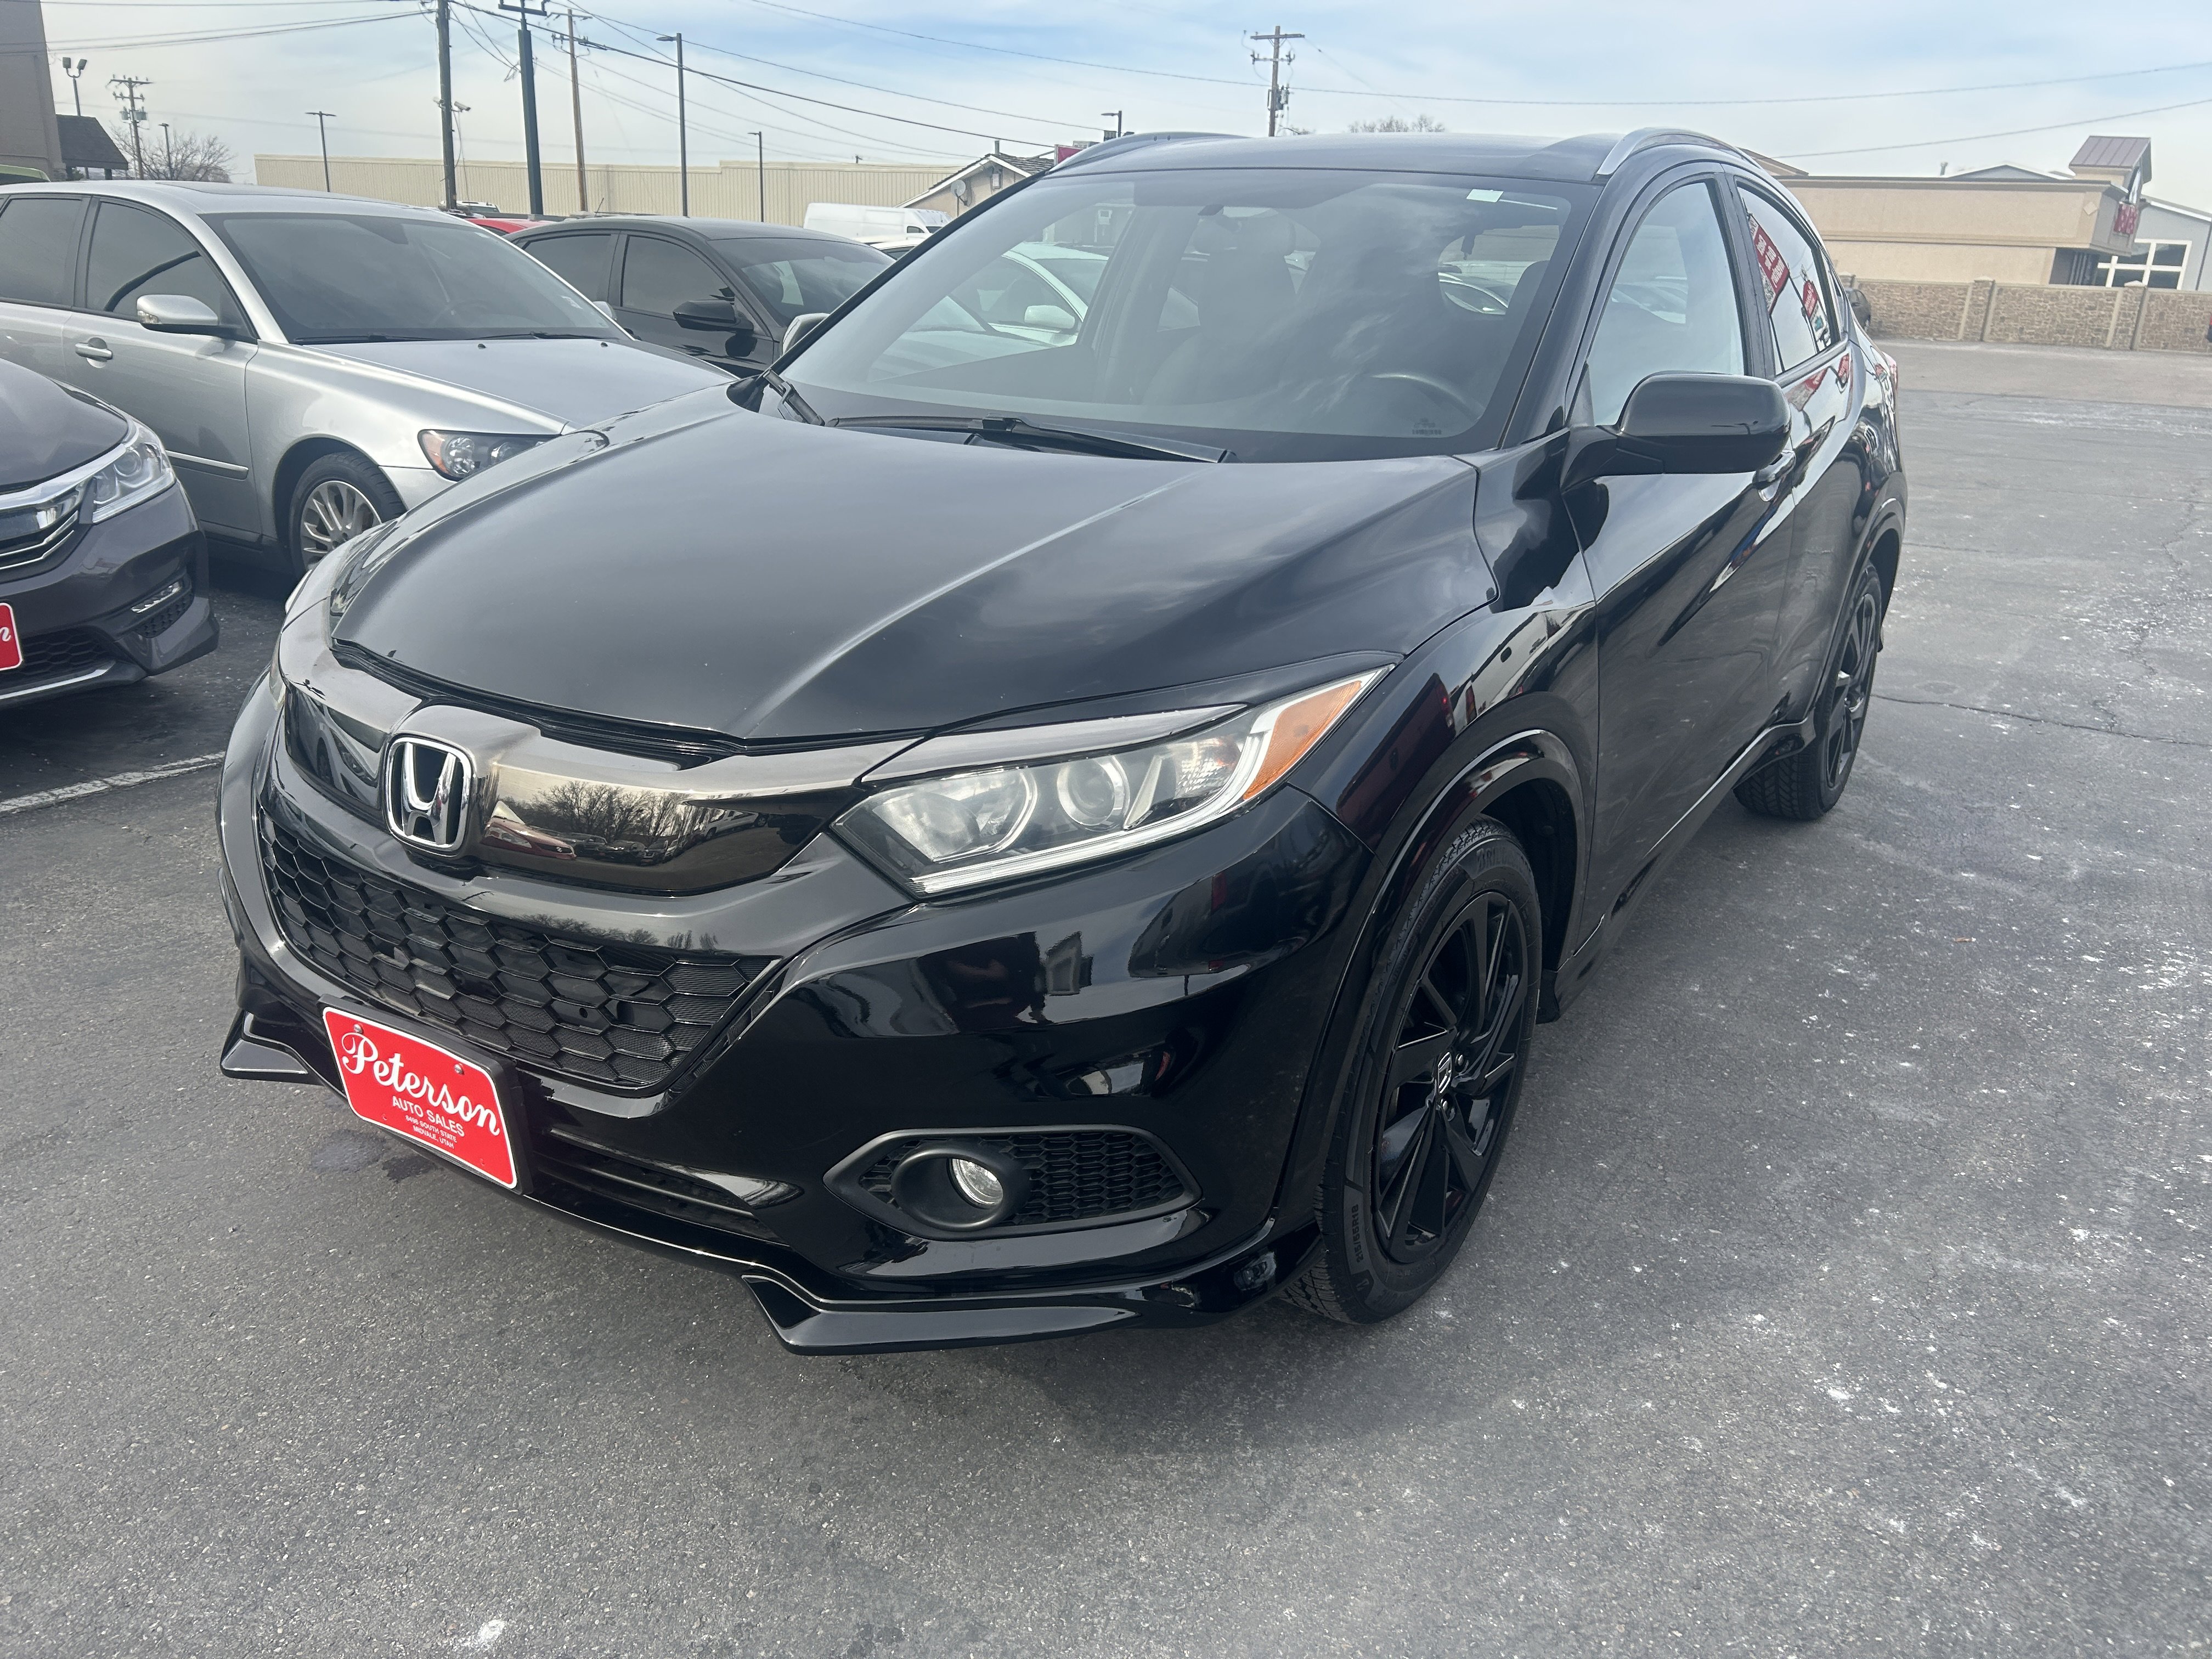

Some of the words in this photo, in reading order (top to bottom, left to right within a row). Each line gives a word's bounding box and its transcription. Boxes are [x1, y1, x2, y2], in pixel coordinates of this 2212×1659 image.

[341, 1031, 500, 1136] Peterson
[392, 1095, 424, 1118] AUTO
[426, 1109, 465, 1137] SALES
[419, 1120, 439, 1135] SOUTH
[439, 1130, 458, 1143] STATE
[439, 1137, 455, 1149] UTAH
